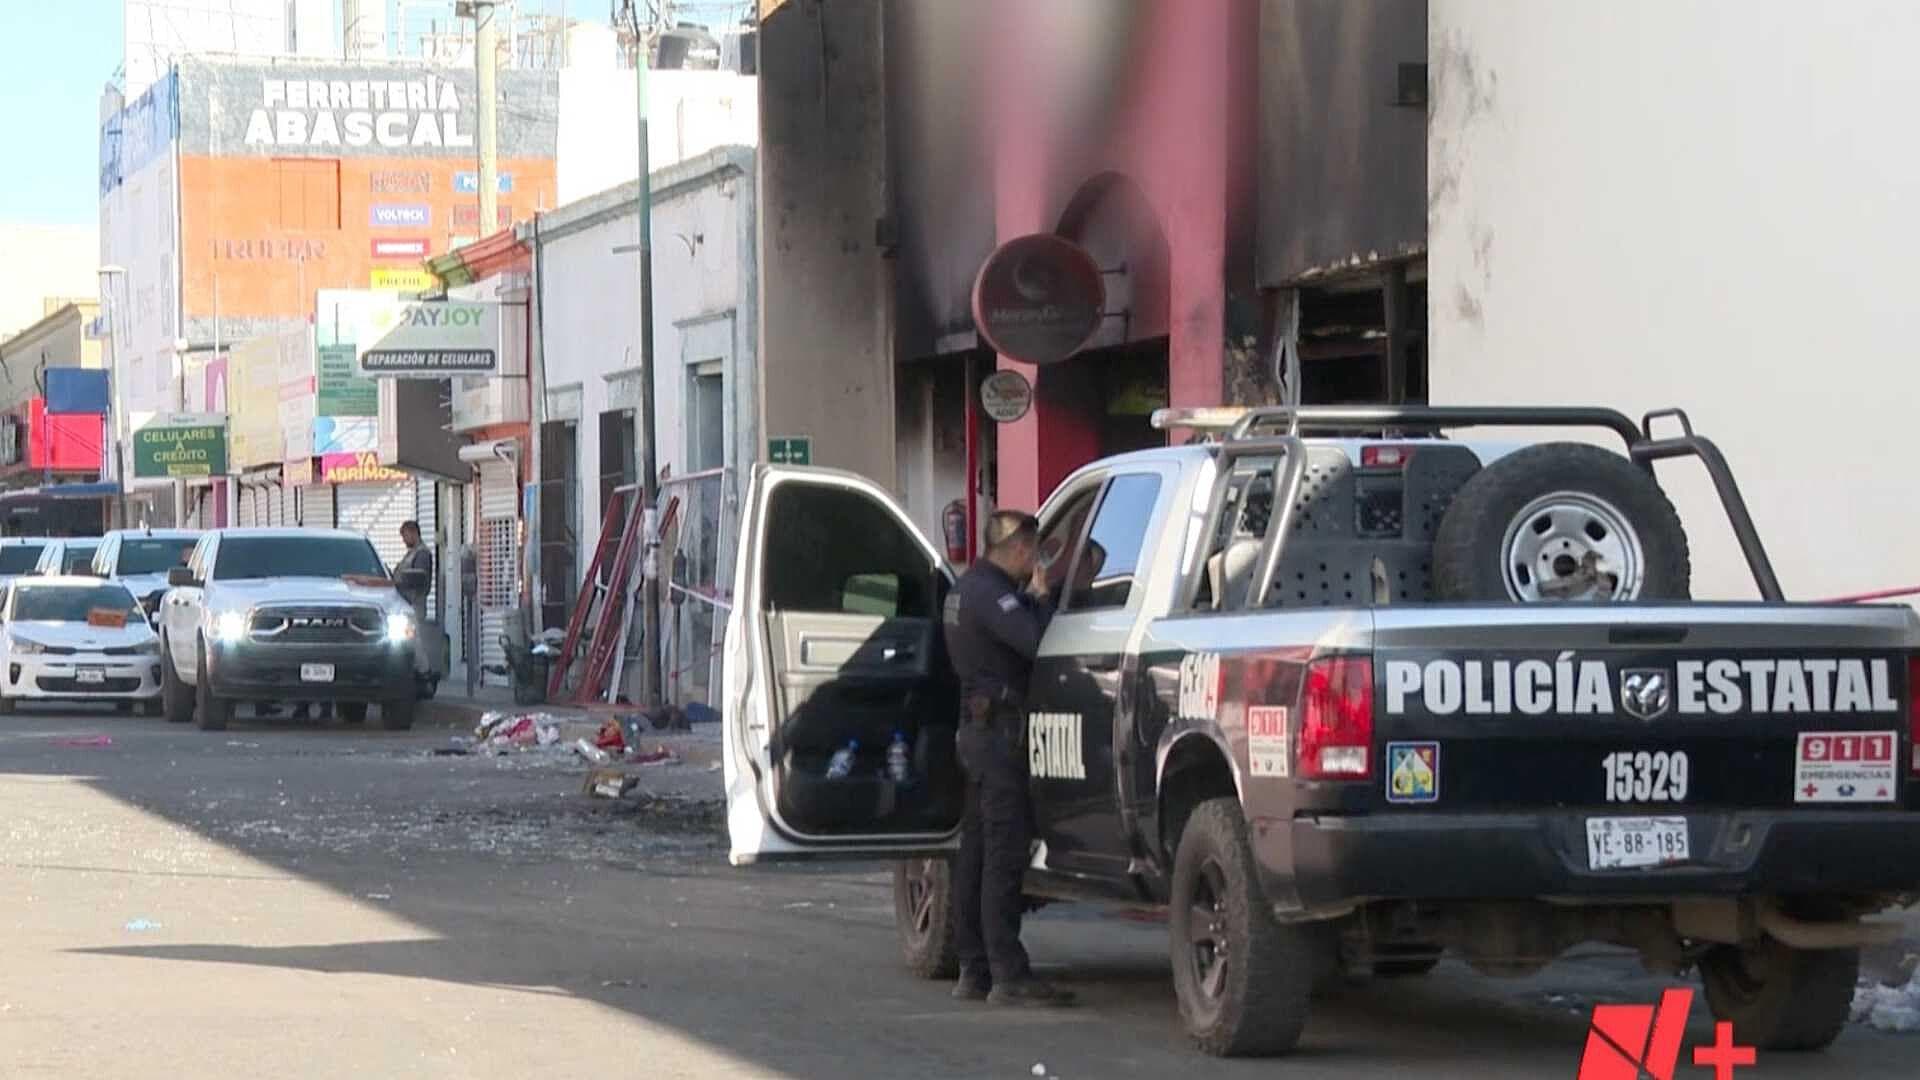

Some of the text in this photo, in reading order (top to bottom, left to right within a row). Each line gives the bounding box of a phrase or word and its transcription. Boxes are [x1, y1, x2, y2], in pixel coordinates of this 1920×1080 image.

[263, 75, 460, 110] FERRETERÍA
[244, 110, 474, 146] ABASCAL
[366, 351, 492, 366] REPARACIÓN DE CELULARES
[143, 428, 215, 443] CELULARES
[175, 440, 185, 450] A
[355, 451, 377, 467] YA
[292, 617, 346, 628] RAM
[1385, 651, 1898, 715] POLICÍA ESTATAL
[1028, 712, 1086, 779] ESTATAL
[1805, 736, 1887, 760] 911
[1602, 751, 1688, 801] 15329
[1800, 769, 1891, 780] EMERGENCIAS
[1593, 831, 1685, 855] VE-88-185
